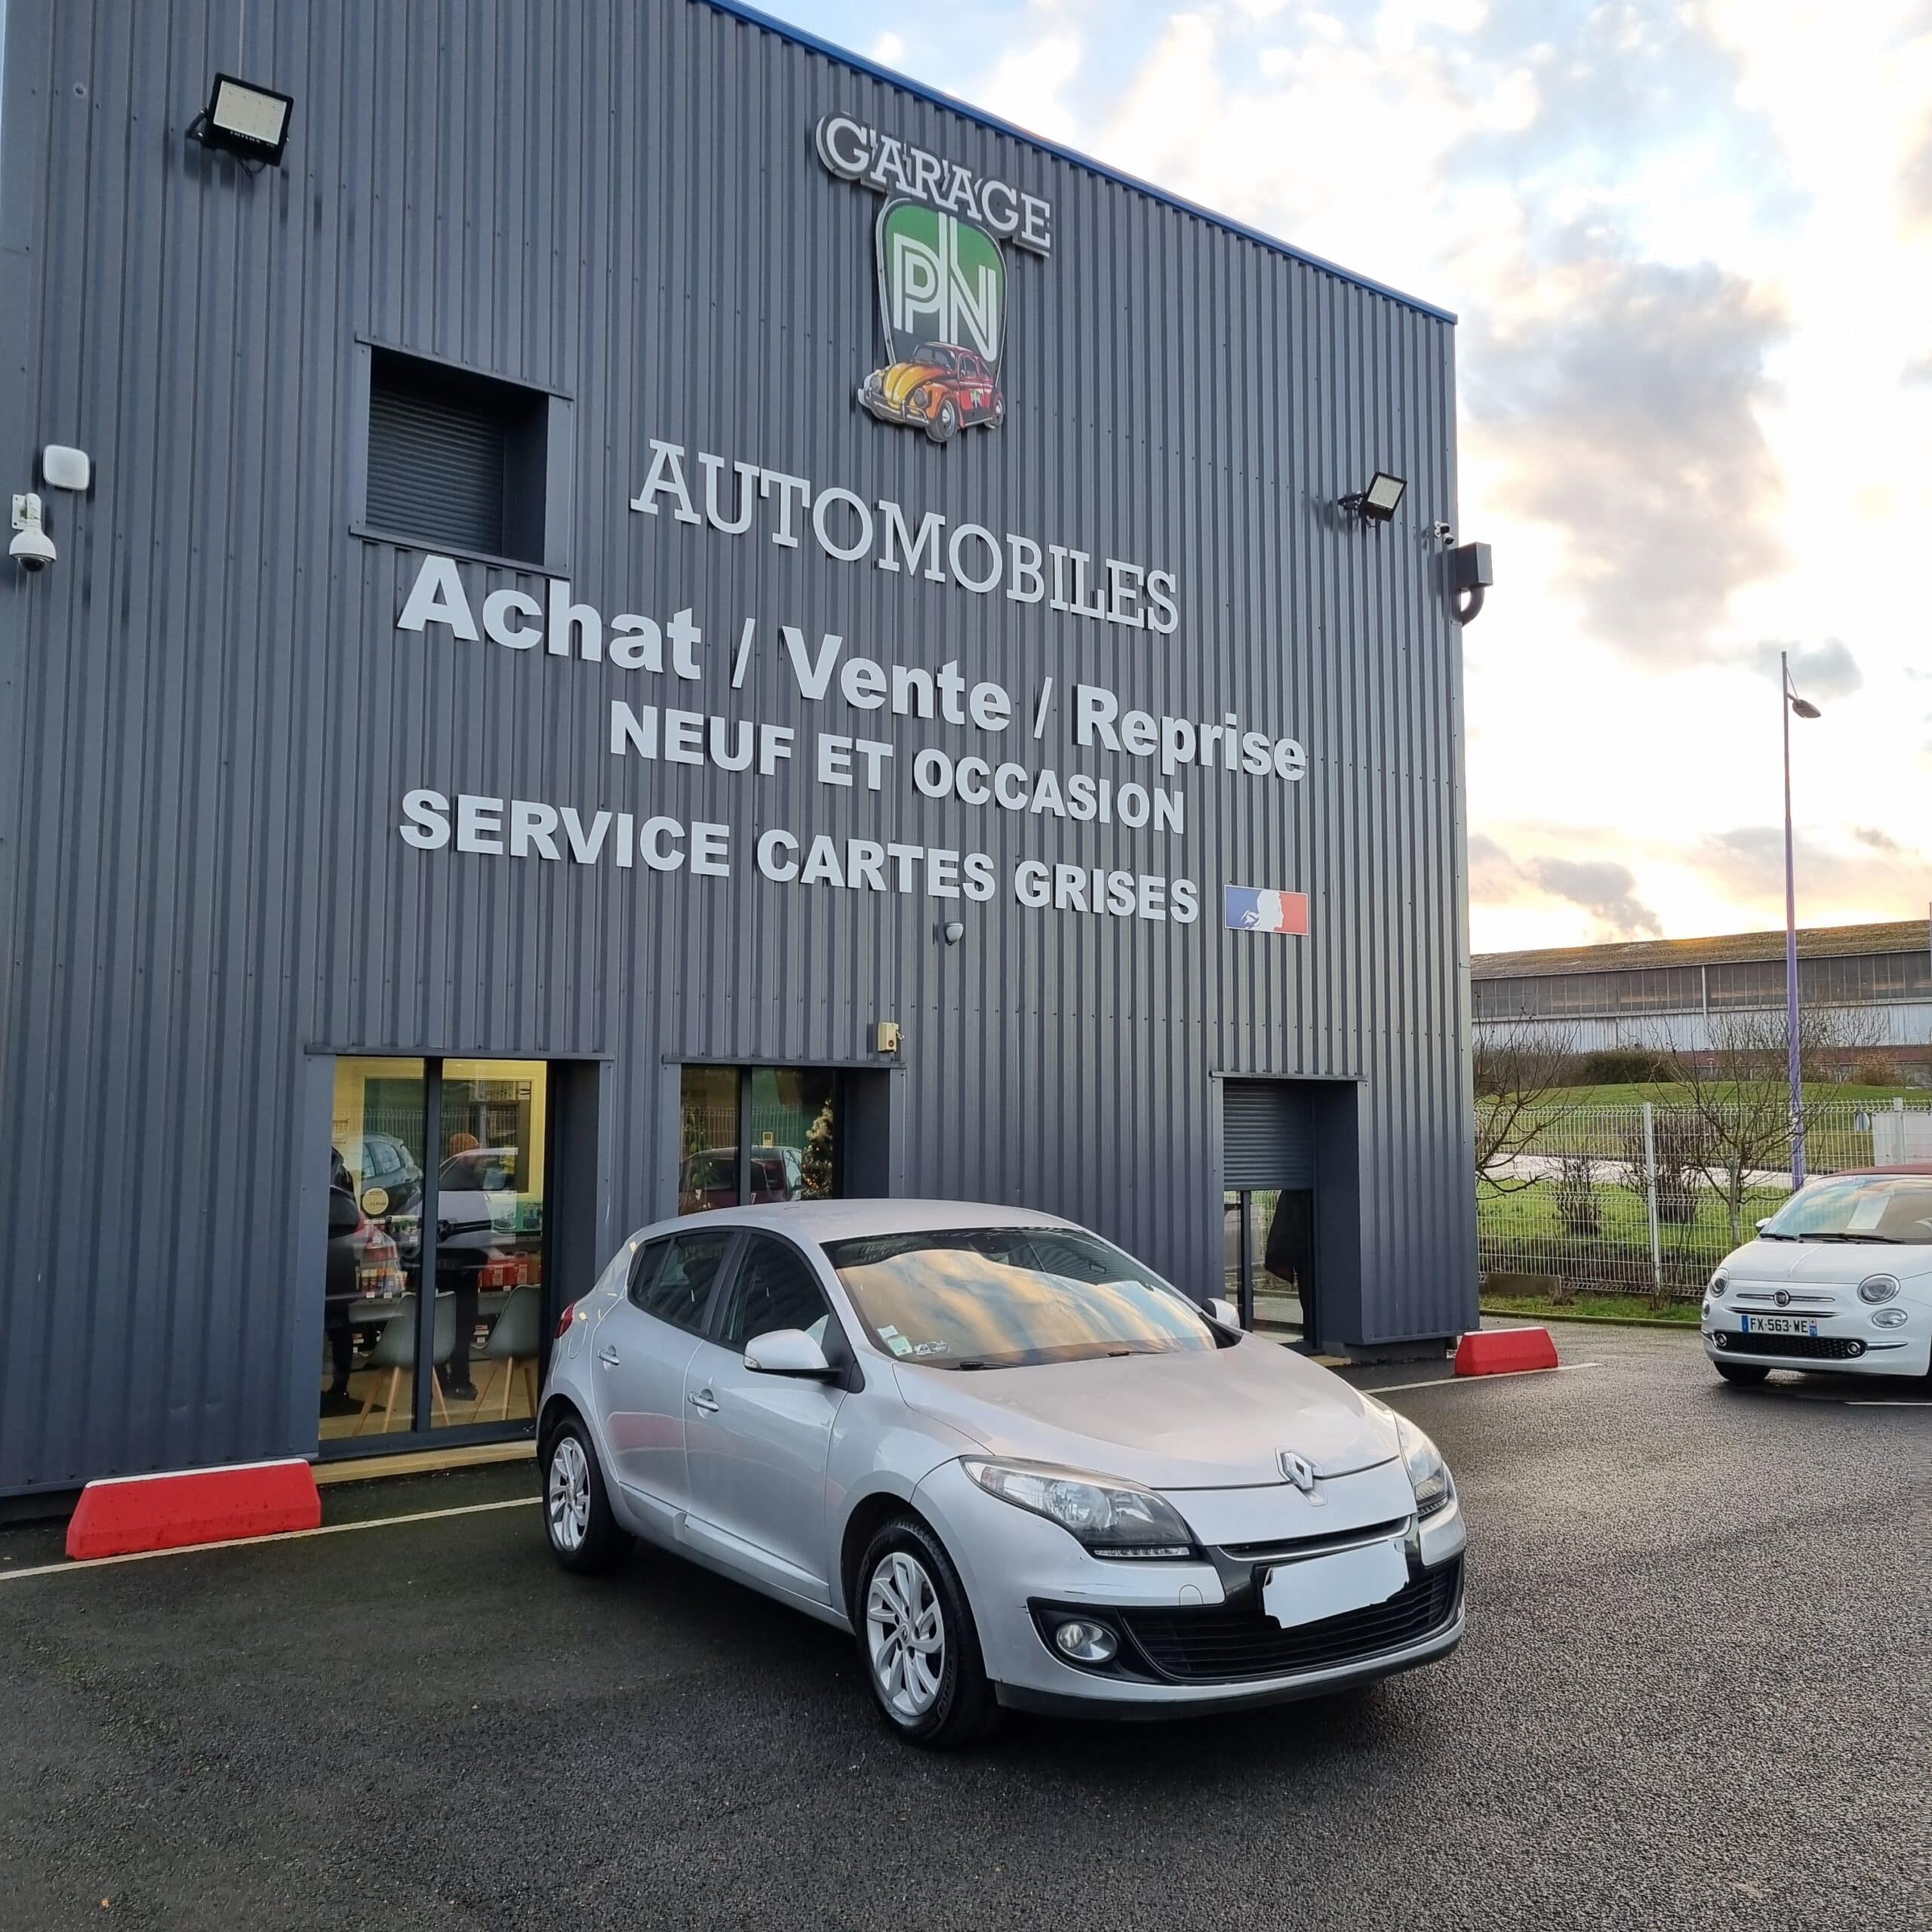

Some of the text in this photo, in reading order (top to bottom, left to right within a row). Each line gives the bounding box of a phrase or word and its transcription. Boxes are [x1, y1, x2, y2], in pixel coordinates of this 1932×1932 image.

[826, 117, 1051, 248] GARAGE
[630, 438, 1179, 634] AUTOMOBILES
[397, 554, 702, 680] Achat
[782, 625, 1011, 731] Vente
[1077, 684, 1306, 781] Reprise
[611, 700, 1184, 835] NEUF ET OCCASION
[399, 789, 1199, 923] SERVICE CARTES GRISES
